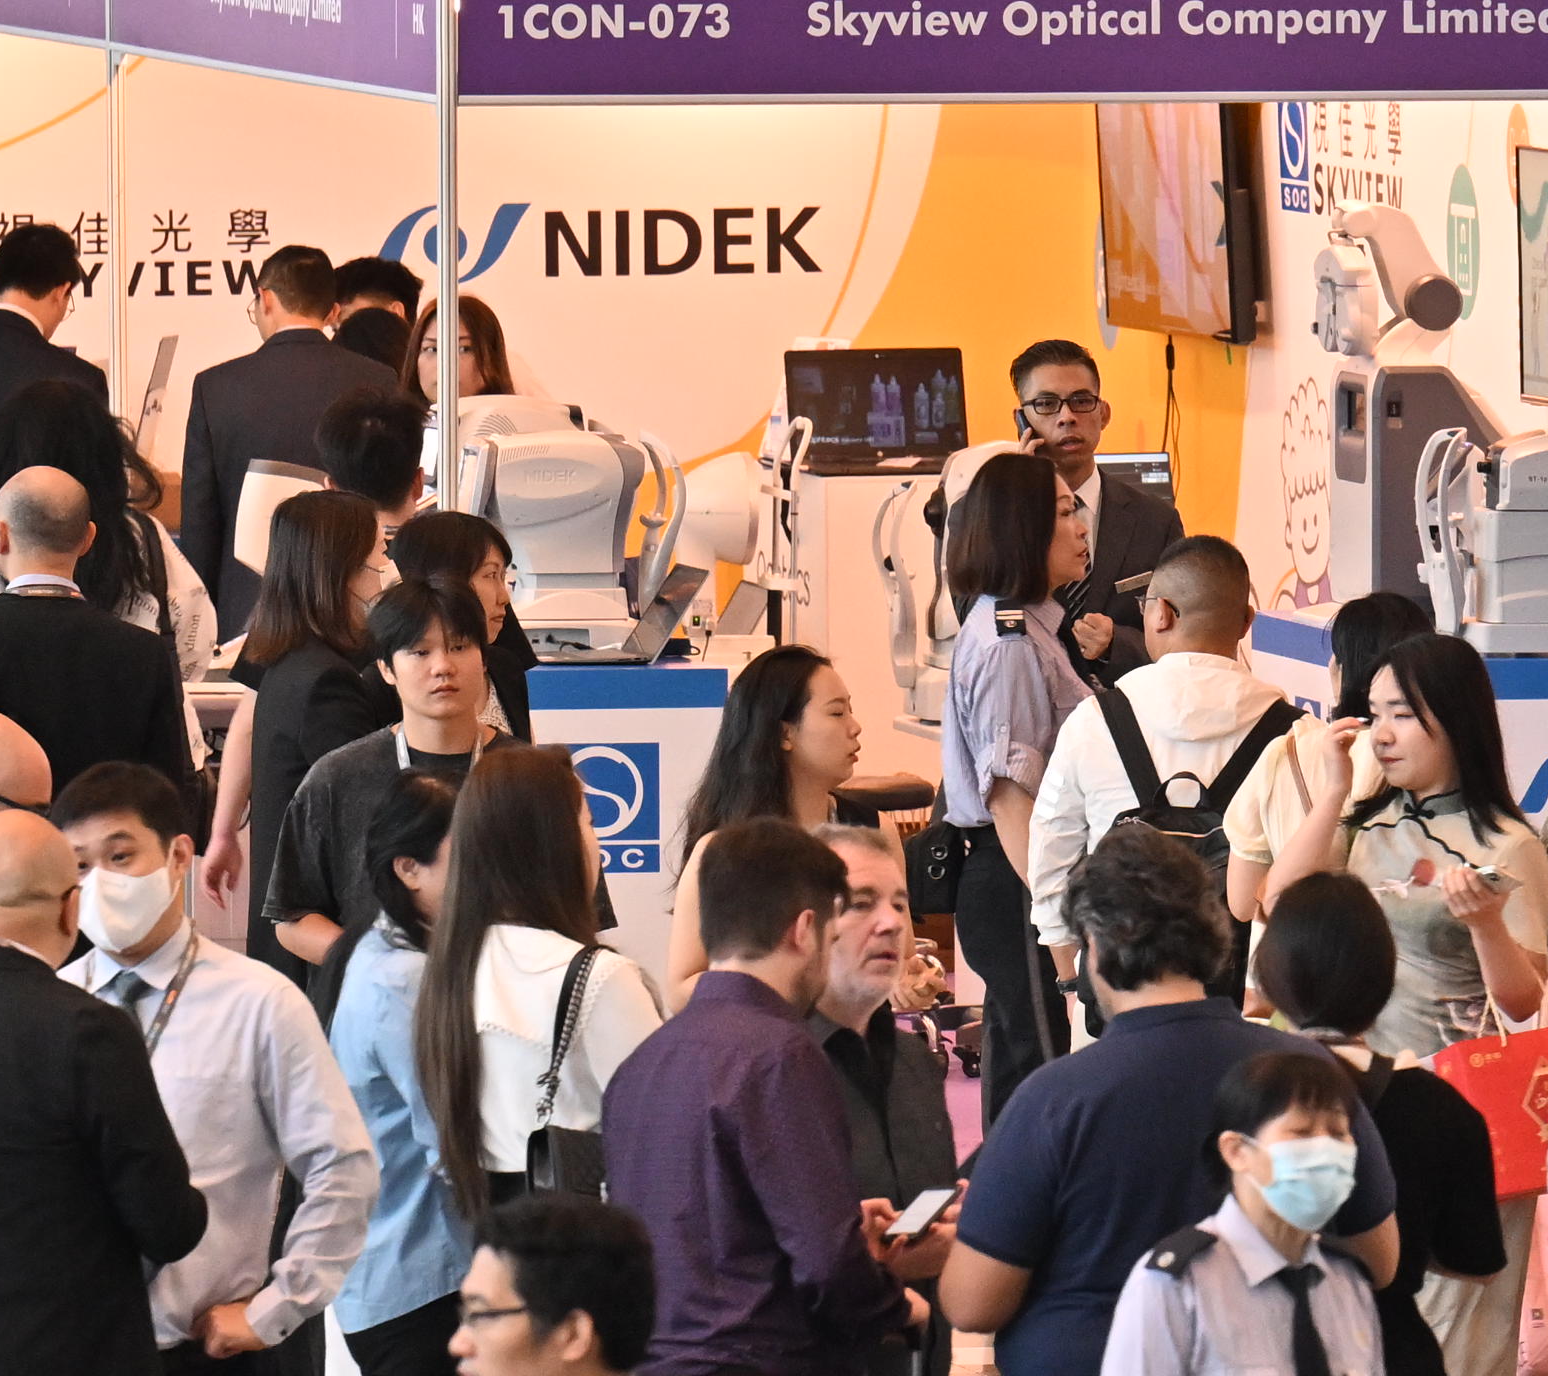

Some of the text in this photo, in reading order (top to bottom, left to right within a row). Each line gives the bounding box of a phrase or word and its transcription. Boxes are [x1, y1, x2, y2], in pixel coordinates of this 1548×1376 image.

[412, 2, 425, 36] HK
[497, 2, 731, 40] 1CON-073
[806, 0, 989, 46] Skyview
[1177, 0, 1387, 45] Company
[1283, 185, 1309, 210] SOC
[544, 206, 823, 278] NIDEK
